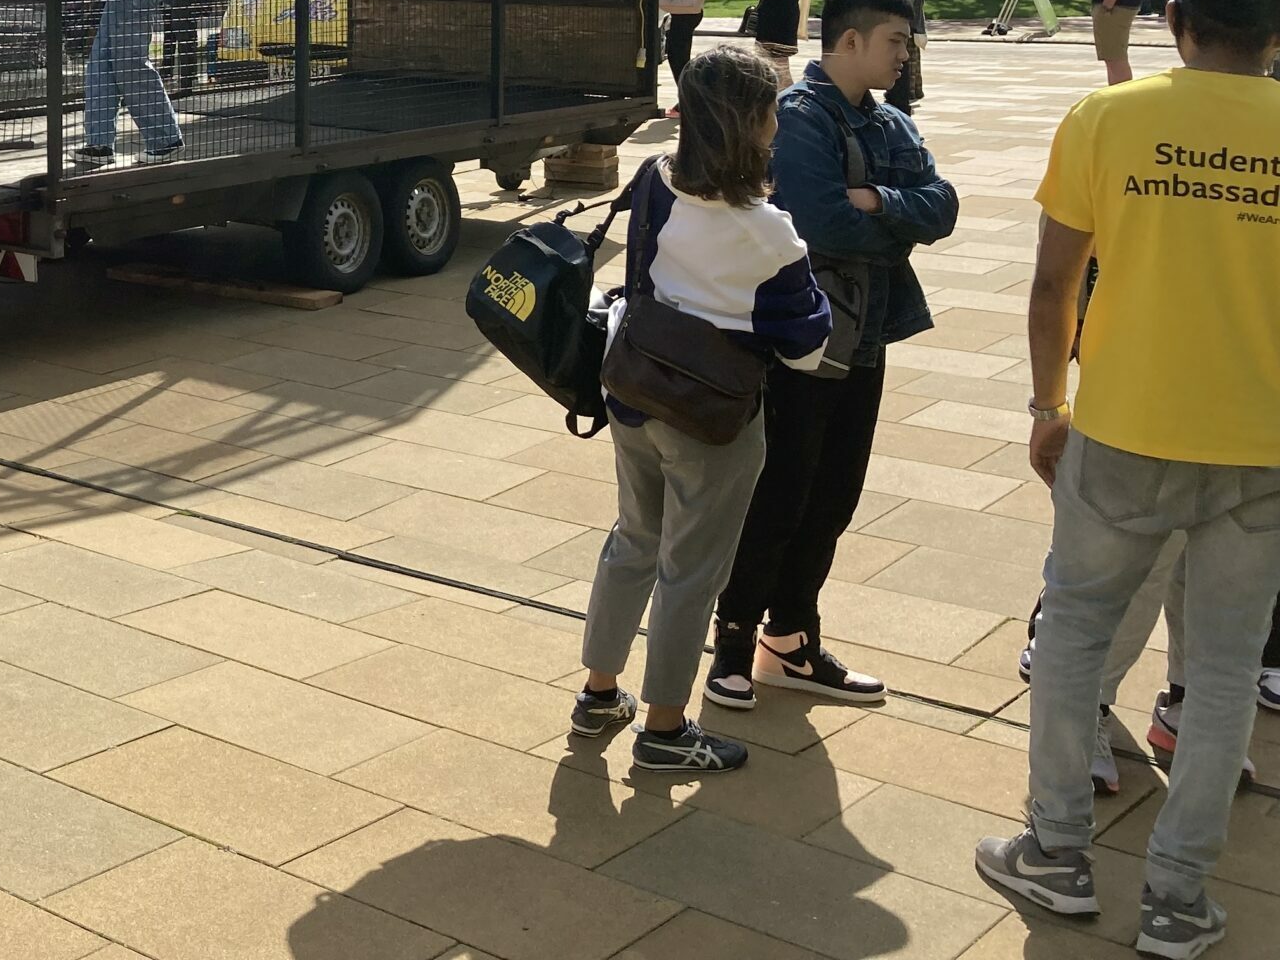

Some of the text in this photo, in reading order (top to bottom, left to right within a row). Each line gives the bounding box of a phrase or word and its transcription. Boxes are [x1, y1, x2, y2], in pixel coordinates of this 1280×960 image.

[1155, 142, 1280, 177] Student
[1124, 173, 1280, 207] Ambassad
[482, 265, 520, 297] NORTH
[509, 271, 530, 289] THE
[484, 285, 511, 308] FACE
